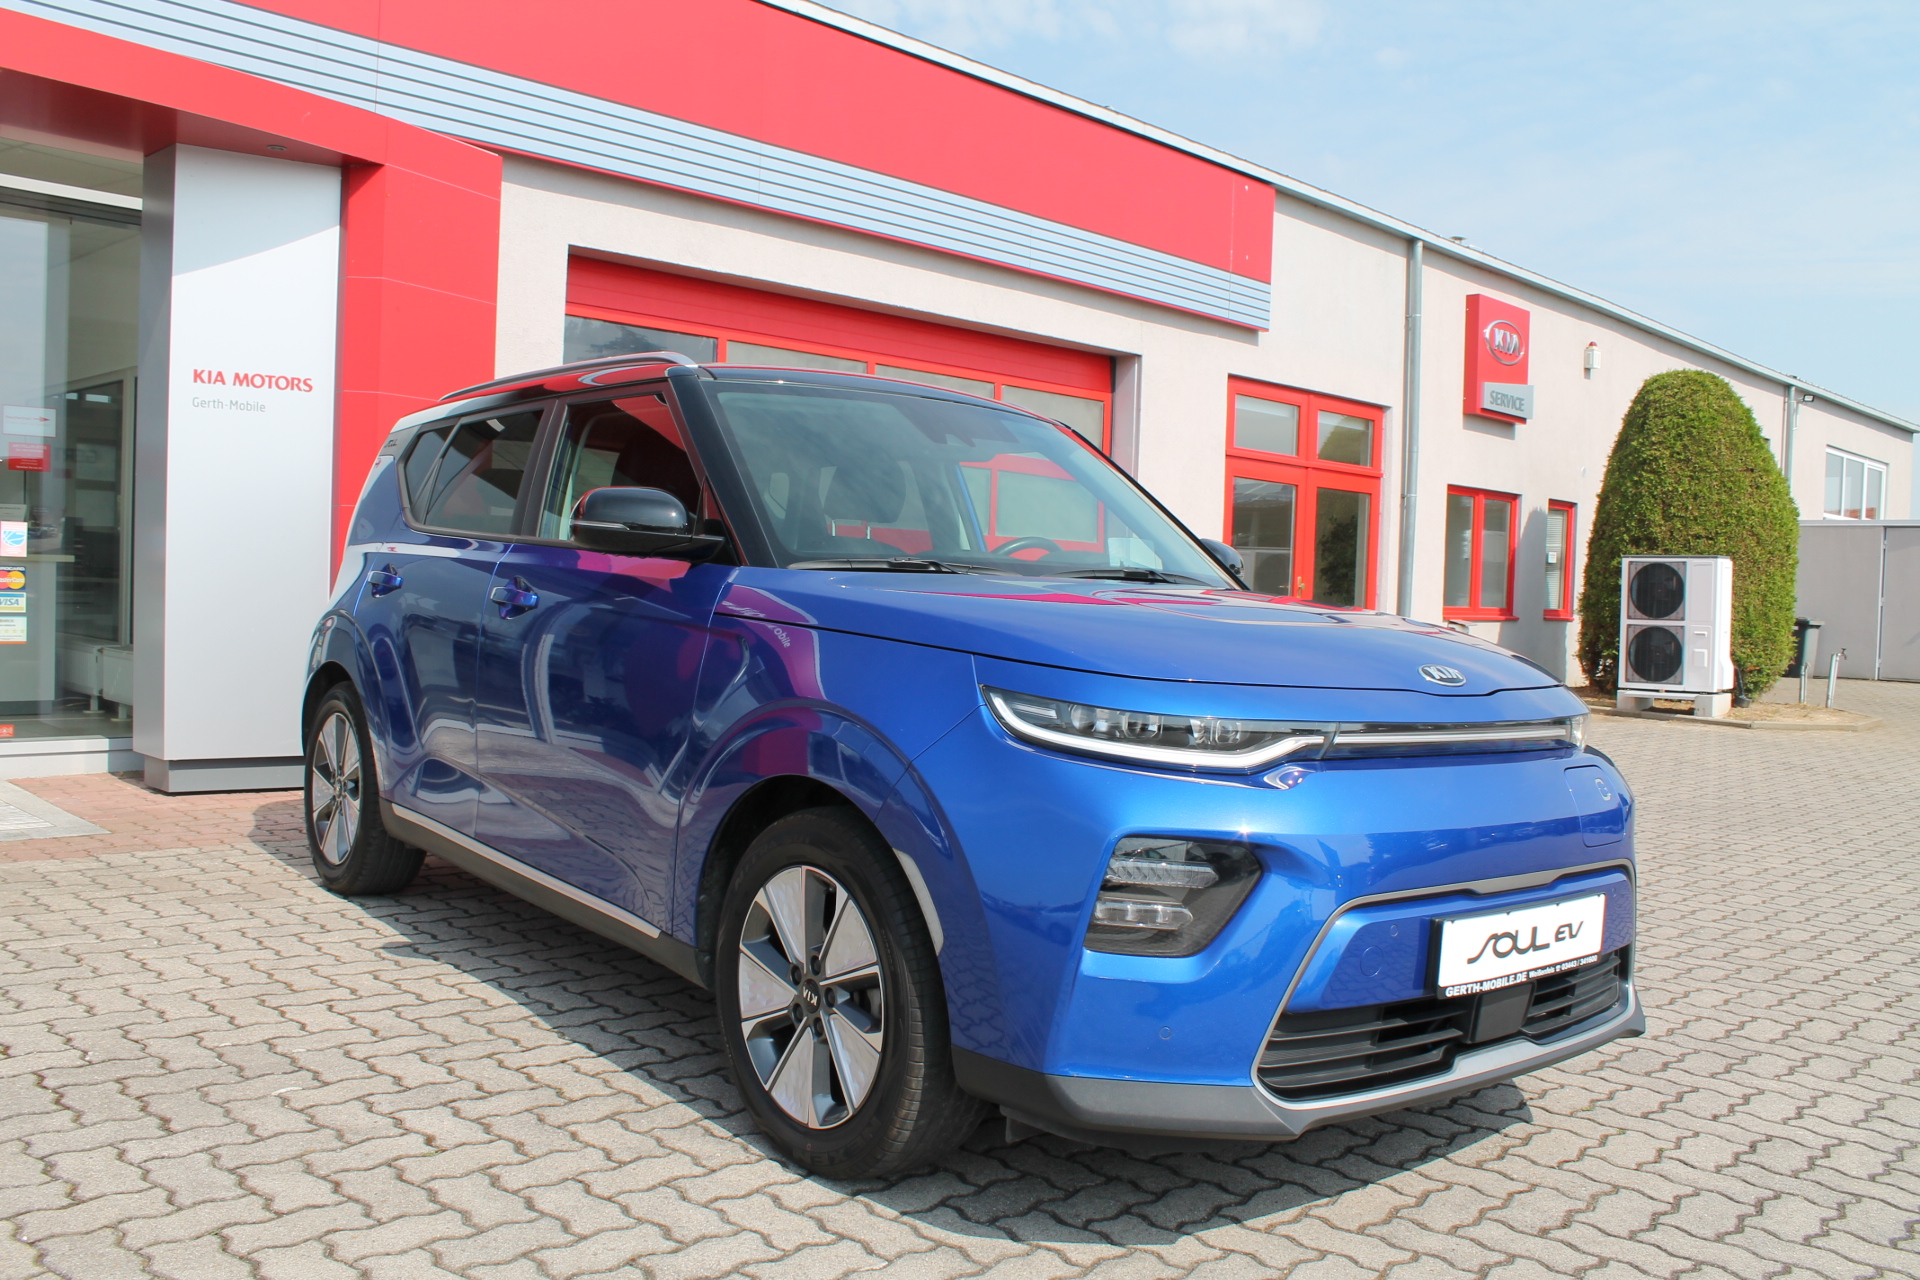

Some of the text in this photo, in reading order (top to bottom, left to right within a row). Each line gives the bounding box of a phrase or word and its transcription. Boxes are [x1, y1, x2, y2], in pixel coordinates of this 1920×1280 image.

[1493, 328, 1520, 356] KIA
[193, 368, 313, 393] KIA MOTORS
[192, 396, 266, 413] Gerth-Mobile
[1489, 390, 1525, 412] SERVICE
[1426, 666, 1460, 680] KIA
[1467, 920, 1584, 964] SOUL EV
[803, 986, 818, 1006] KIA
[1445, 971, 1528, 998] GERTH-MOBILE.DE
